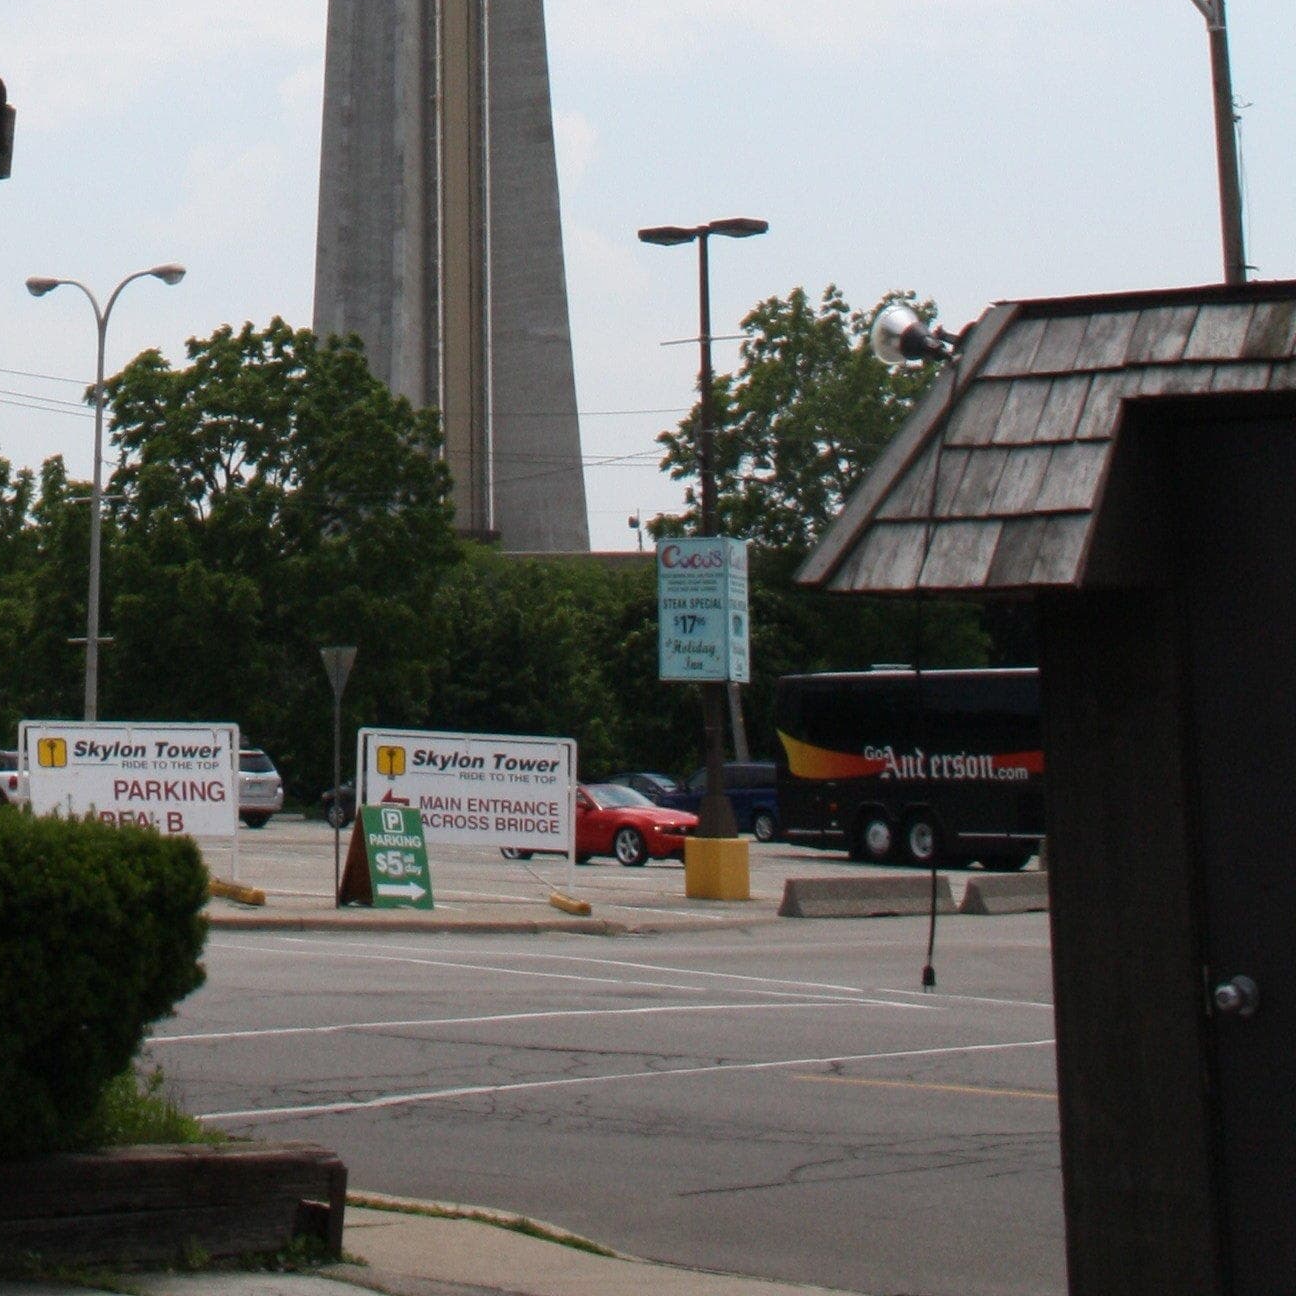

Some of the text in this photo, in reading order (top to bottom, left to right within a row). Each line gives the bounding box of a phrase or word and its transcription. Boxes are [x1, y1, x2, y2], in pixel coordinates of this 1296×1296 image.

[663, 598, 687, 609] STEAK
[689, 598, 722, 609] SPECIAL
[671, 640, 716, 657] Holiday
[73, 740, 222, 762] Skylon Tower
[412, 749, 560, 773] Skylon Tower
[122, 761, 220, 770] RIDE TO THE TOP
[459, 771, 557, 784] RIDE TO THE TOP
[114, 780, 225, 802] PARKING
[420, 796, 559, 816] MAIN ENTRANCE
[168, 812, 184, 832] B
[421, 814, 560, 834] ACROSS BRIDGE
[369, 833, 422, 848] PARKING
[376, 850, 404, 876] $5
